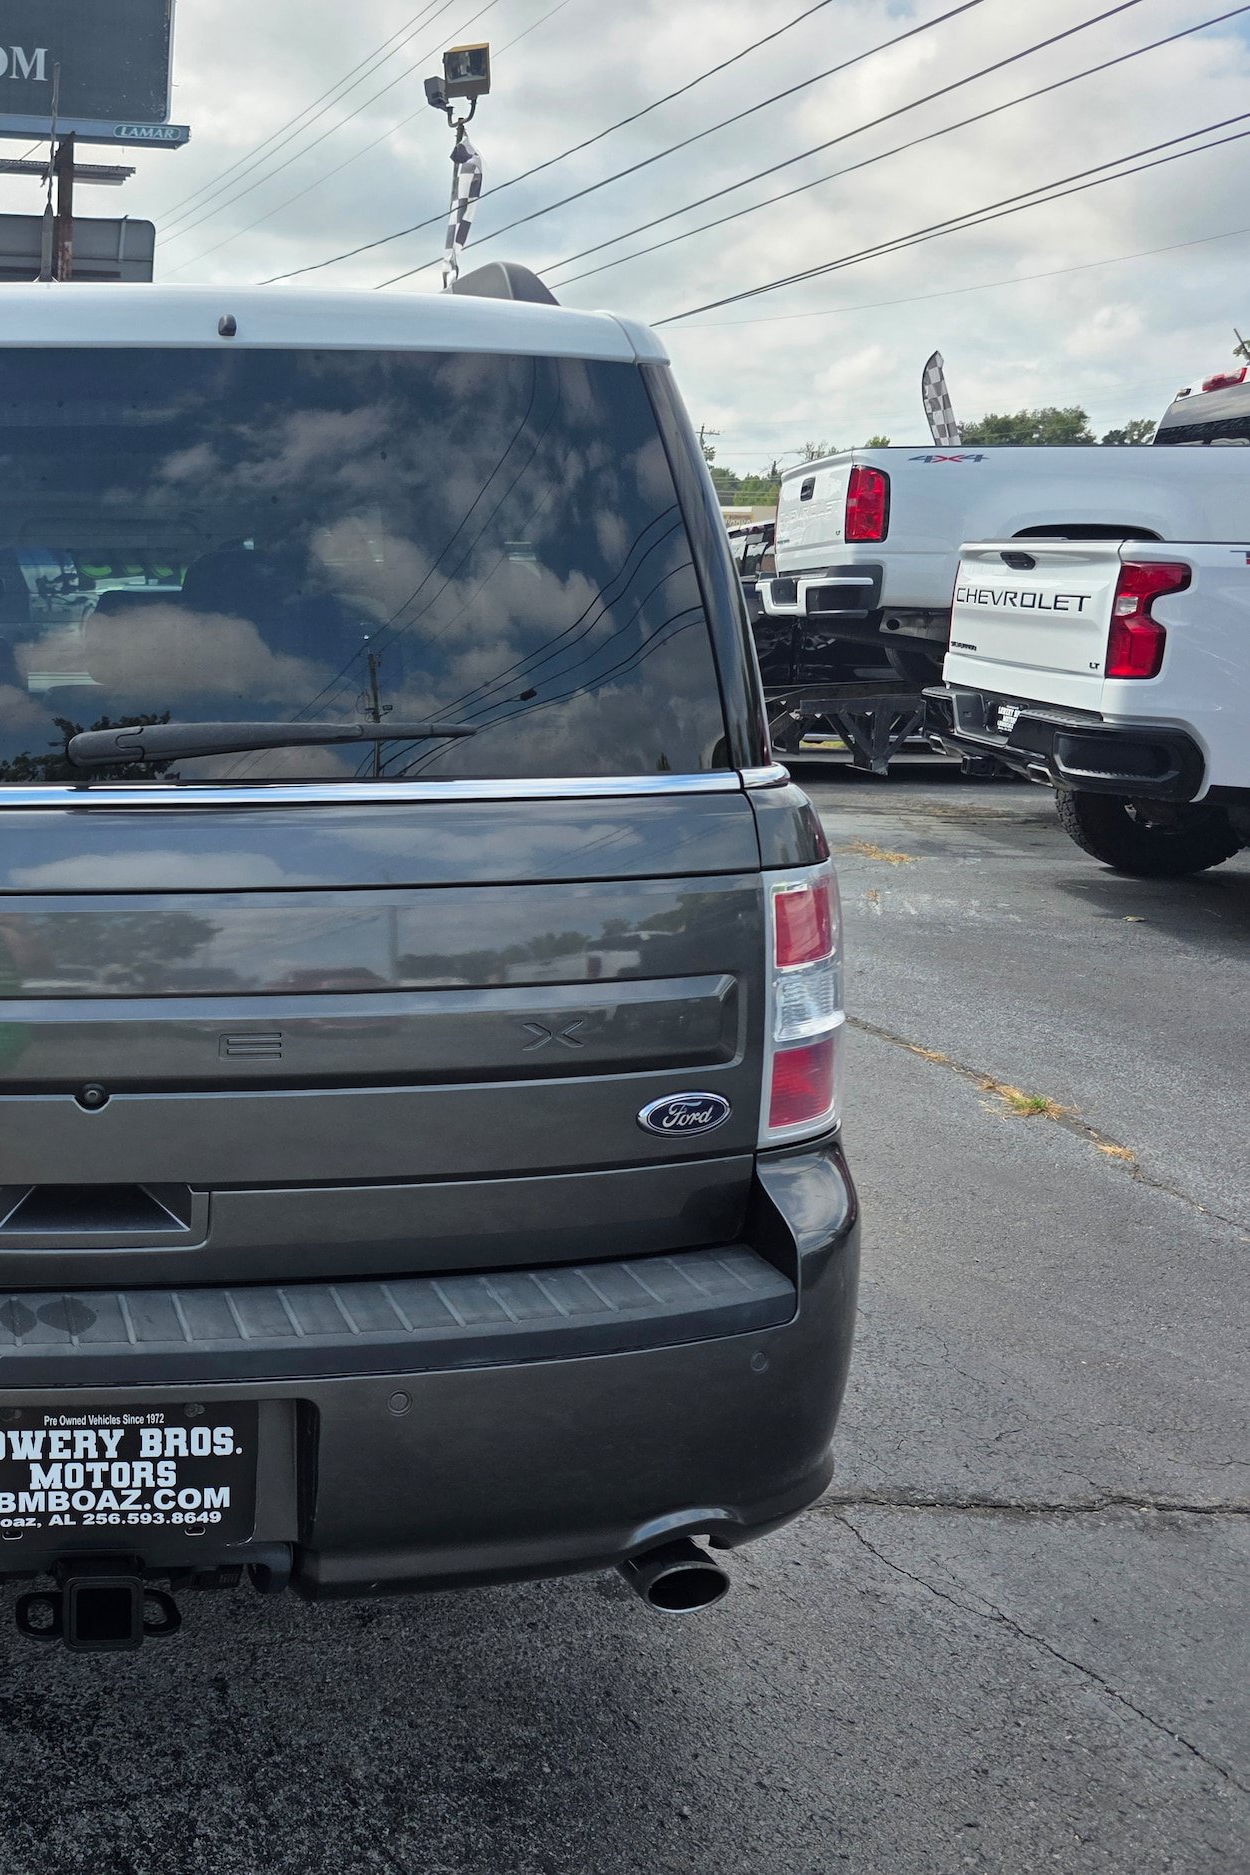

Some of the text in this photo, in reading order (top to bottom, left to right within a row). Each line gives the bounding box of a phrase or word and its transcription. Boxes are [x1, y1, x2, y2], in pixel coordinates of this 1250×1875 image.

[120, 126, 175, 138] LAMAR
[956, 587, 1092, 612] CHEVROLET
[1088, 661, 1100, 670] LT
[662, 1101, 714, 1128] Ford
[43, 1413, 165, 1426] Pre Owned Vehicles Since 1972
[139, 1426, 243, 1458] BROS.
[29, 1460, 177, 1490] MOTORS
[48, 1514, 77, 1526] AL
[82, 1511, 223, 1526] 256.593.8649
